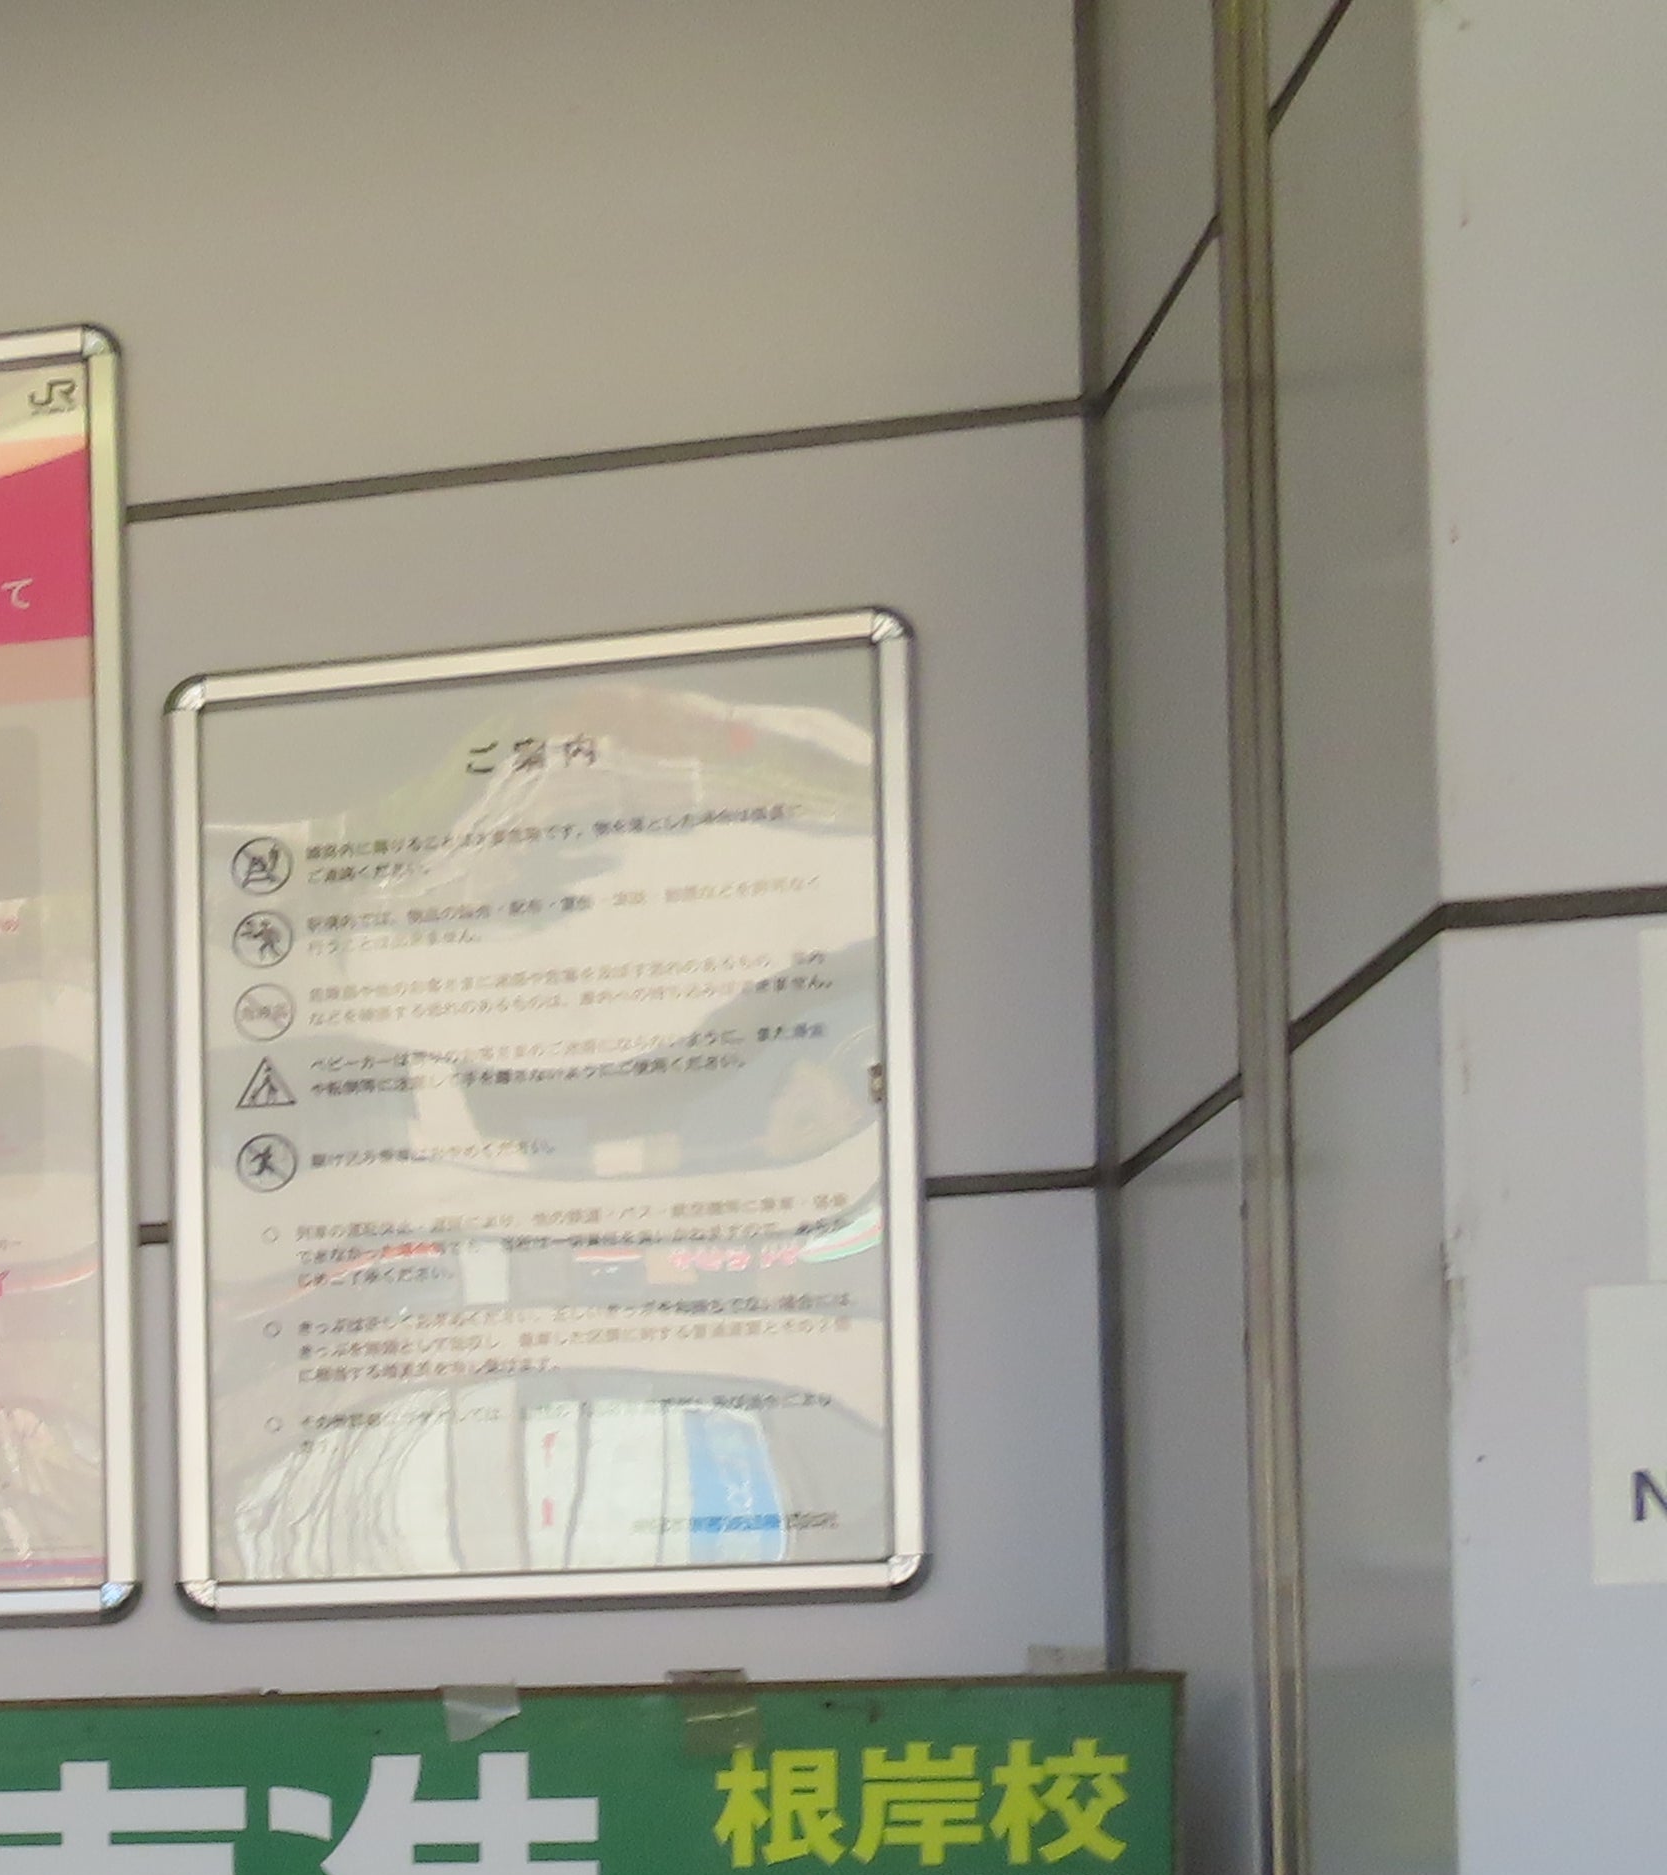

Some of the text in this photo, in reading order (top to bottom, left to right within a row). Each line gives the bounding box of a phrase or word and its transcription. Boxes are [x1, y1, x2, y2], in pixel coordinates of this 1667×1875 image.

[466, 731, 597, 775] ご案内
[712, 1736, 1130, 1869] 根岸校
